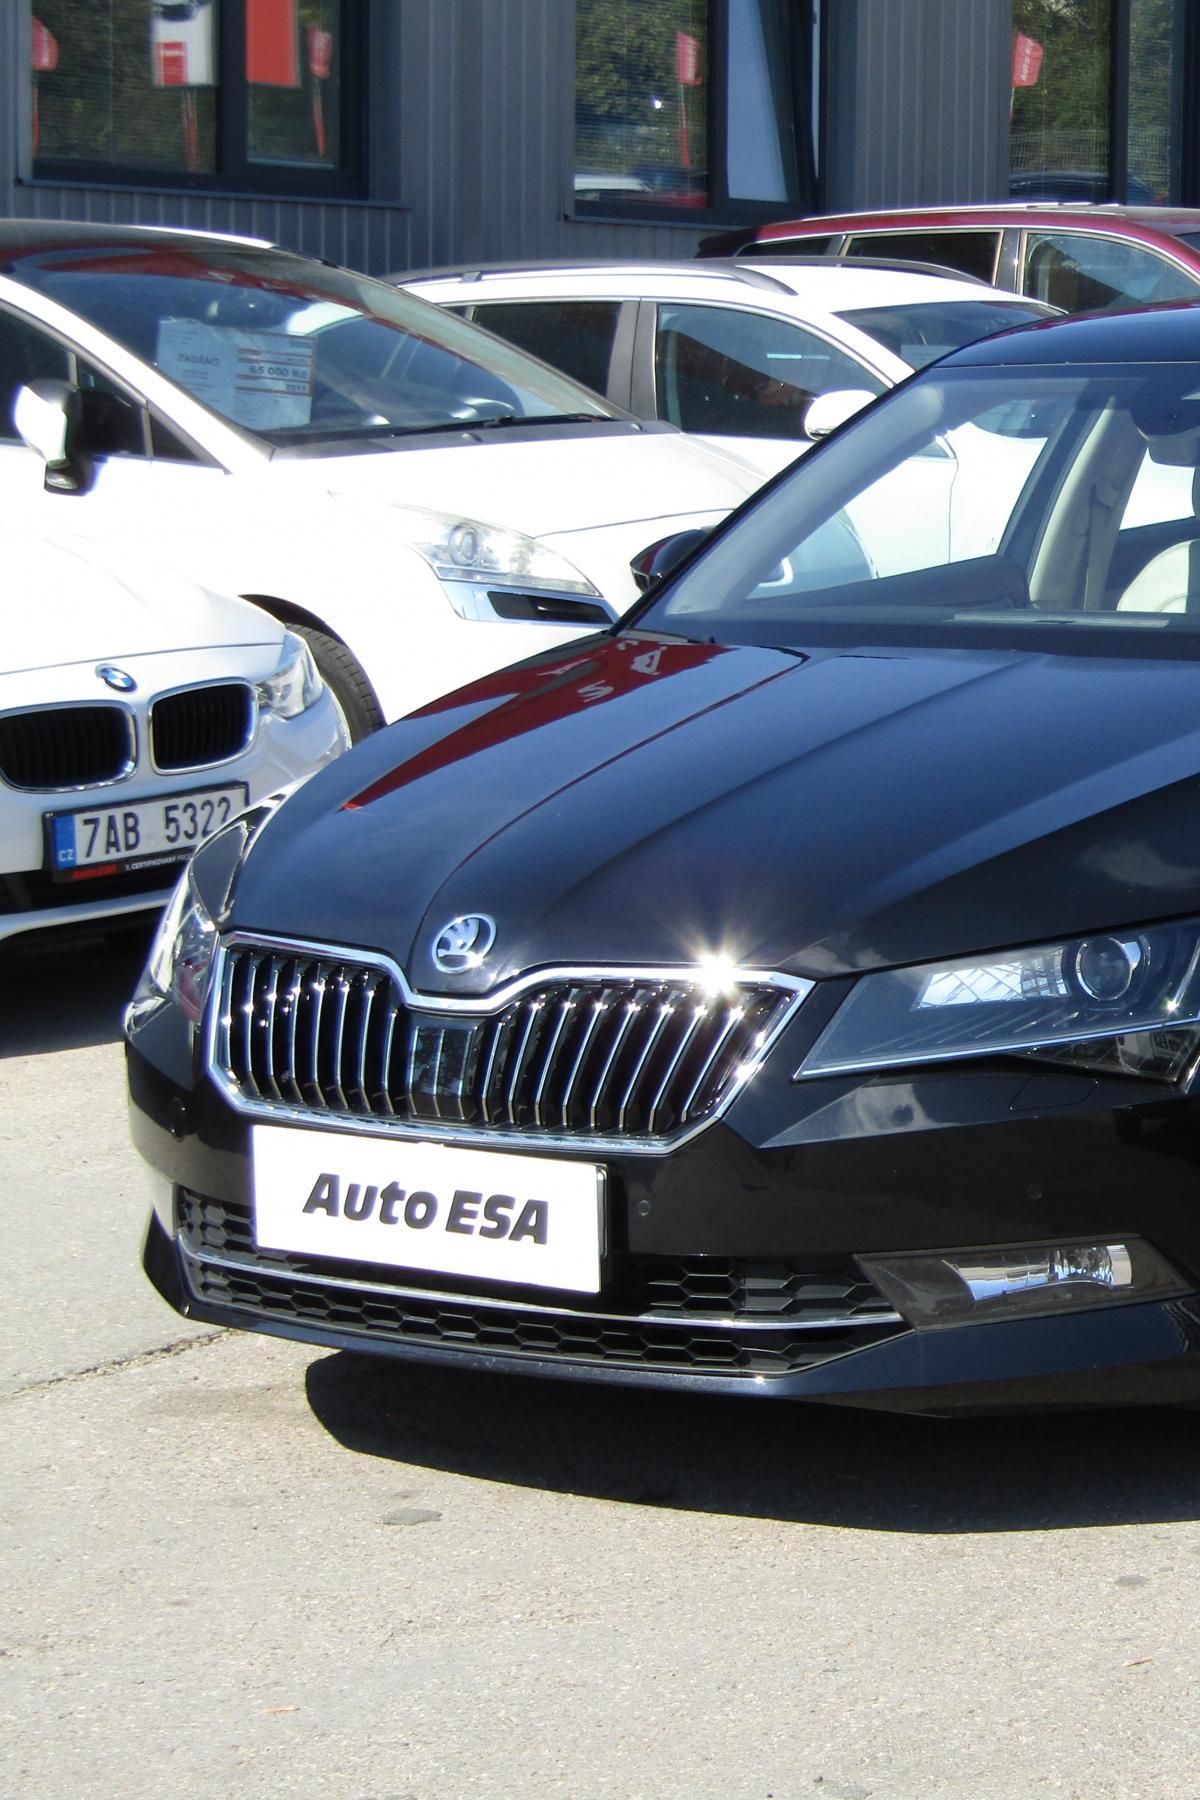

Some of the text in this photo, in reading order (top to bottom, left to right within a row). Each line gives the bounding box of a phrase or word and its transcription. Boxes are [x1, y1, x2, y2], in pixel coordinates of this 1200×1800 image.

[58, 848, 75, 862] CZ
[83, 811, 140, 858] 7AB
[302, 1172, 549, 1245] Auto ESA
